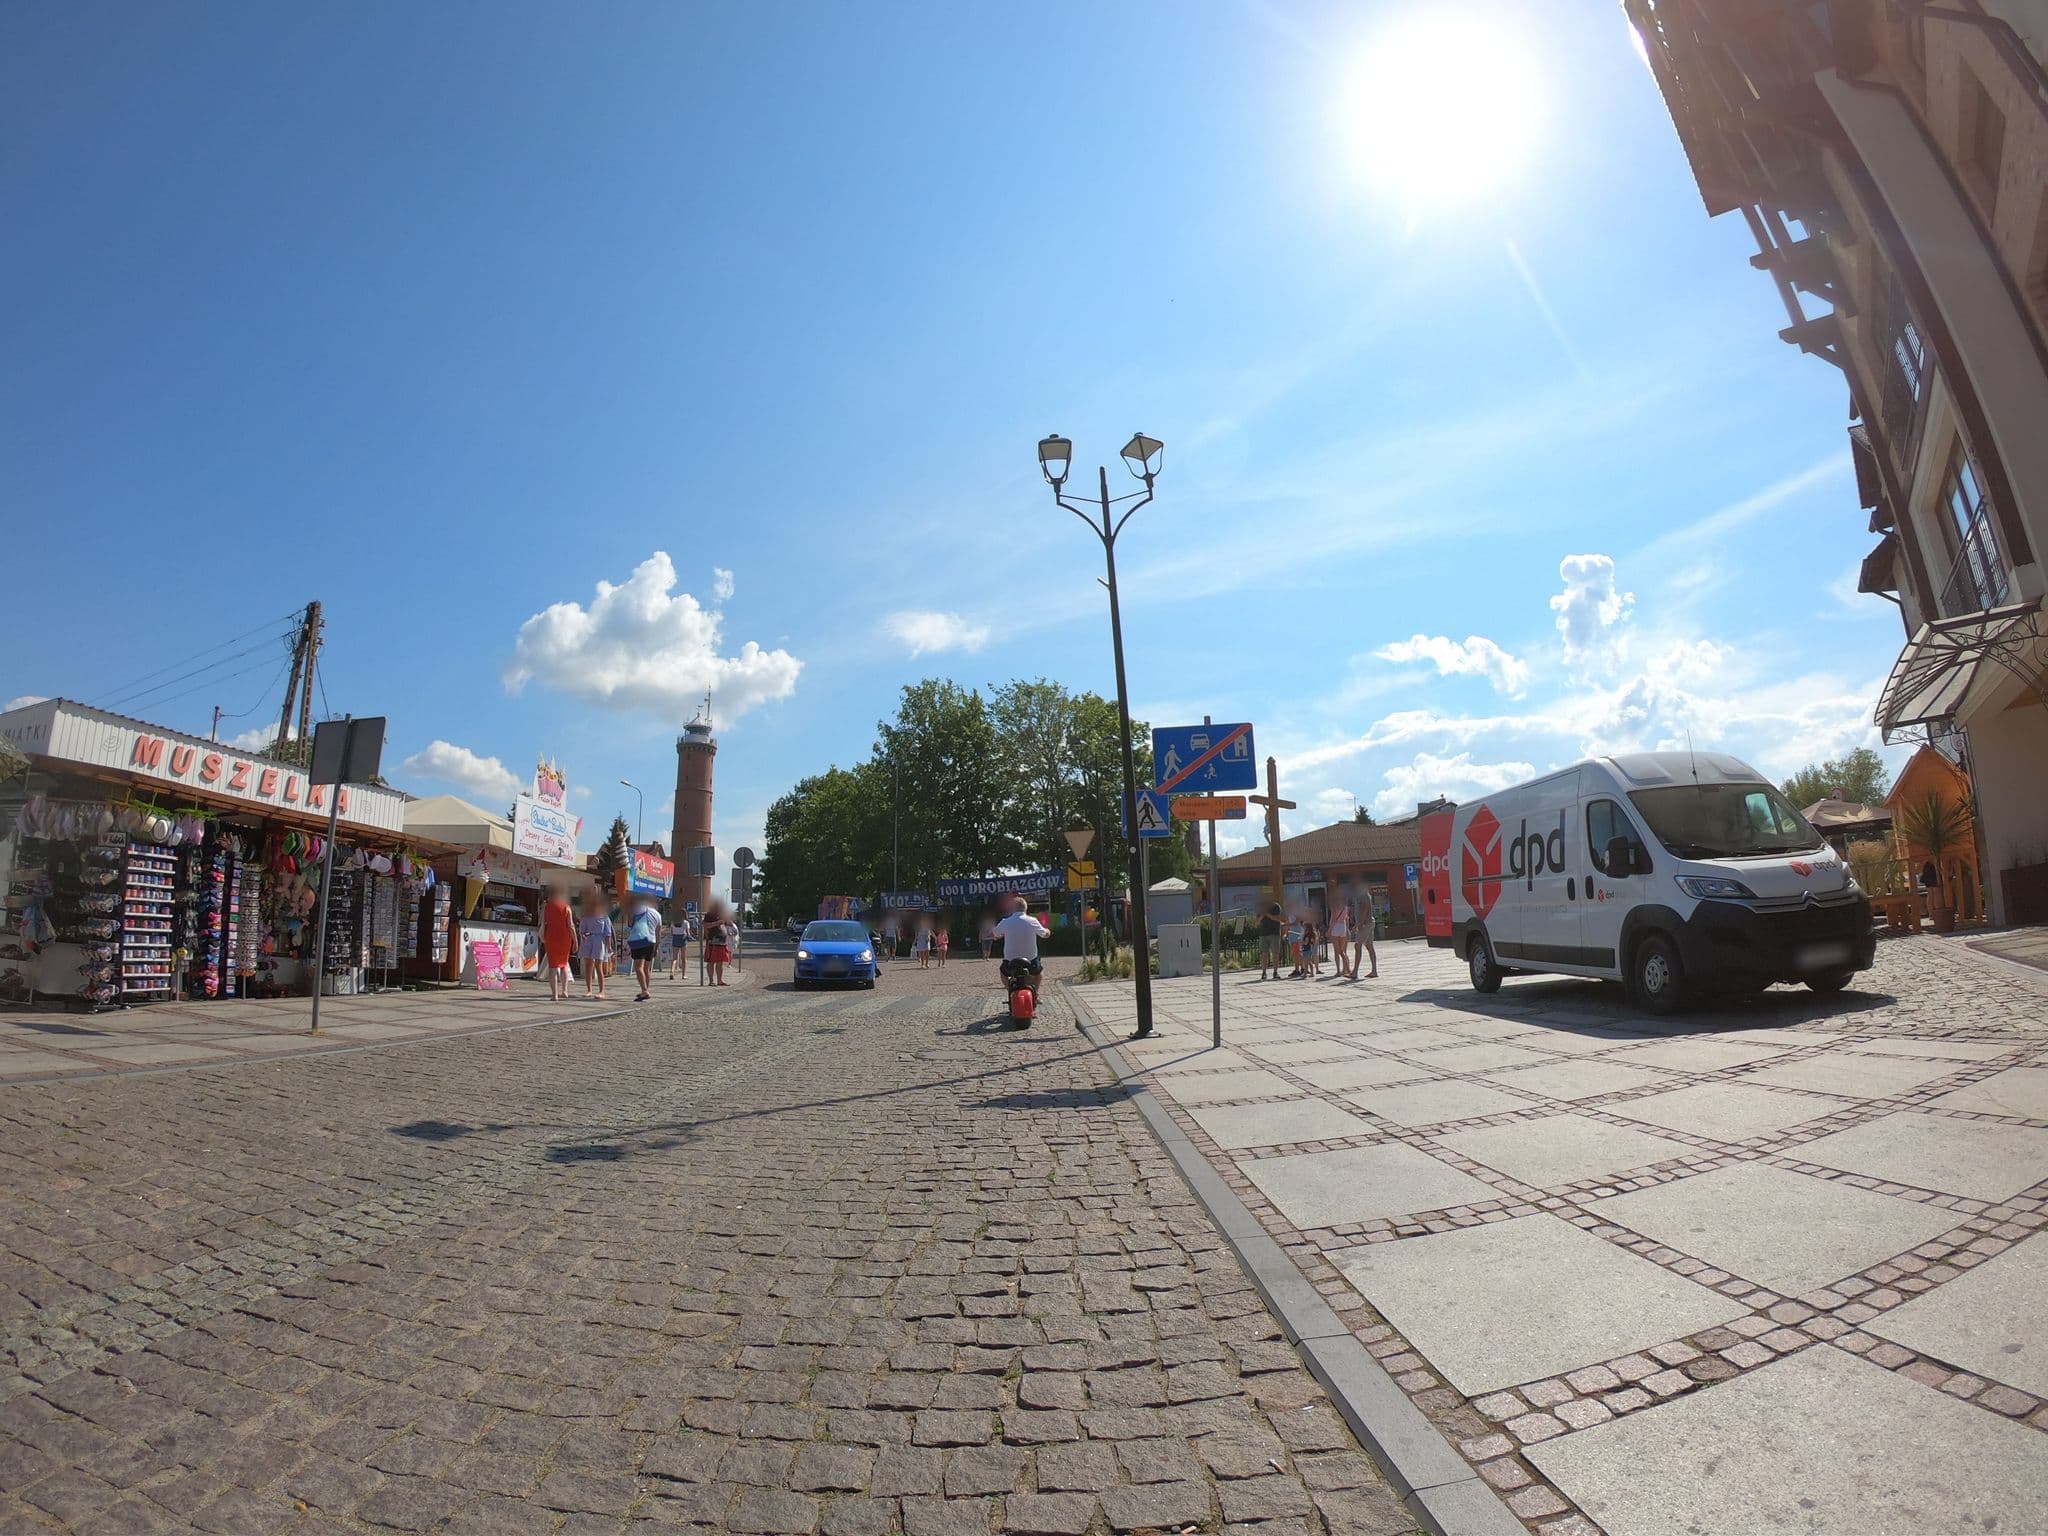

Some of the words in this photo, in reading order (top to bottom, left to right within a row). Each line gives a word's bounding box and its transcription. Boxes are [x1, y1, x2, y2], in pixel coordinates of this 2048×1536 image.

[132, 735, 349, 812] MUSZELKA
[1510, 807, 1566, 892] dpd
[1813, 859, 1837, 872] dpd
[939, 884, 964, 896] 1001
[968, 873, 1061, 896] DROBIAZGÓW
